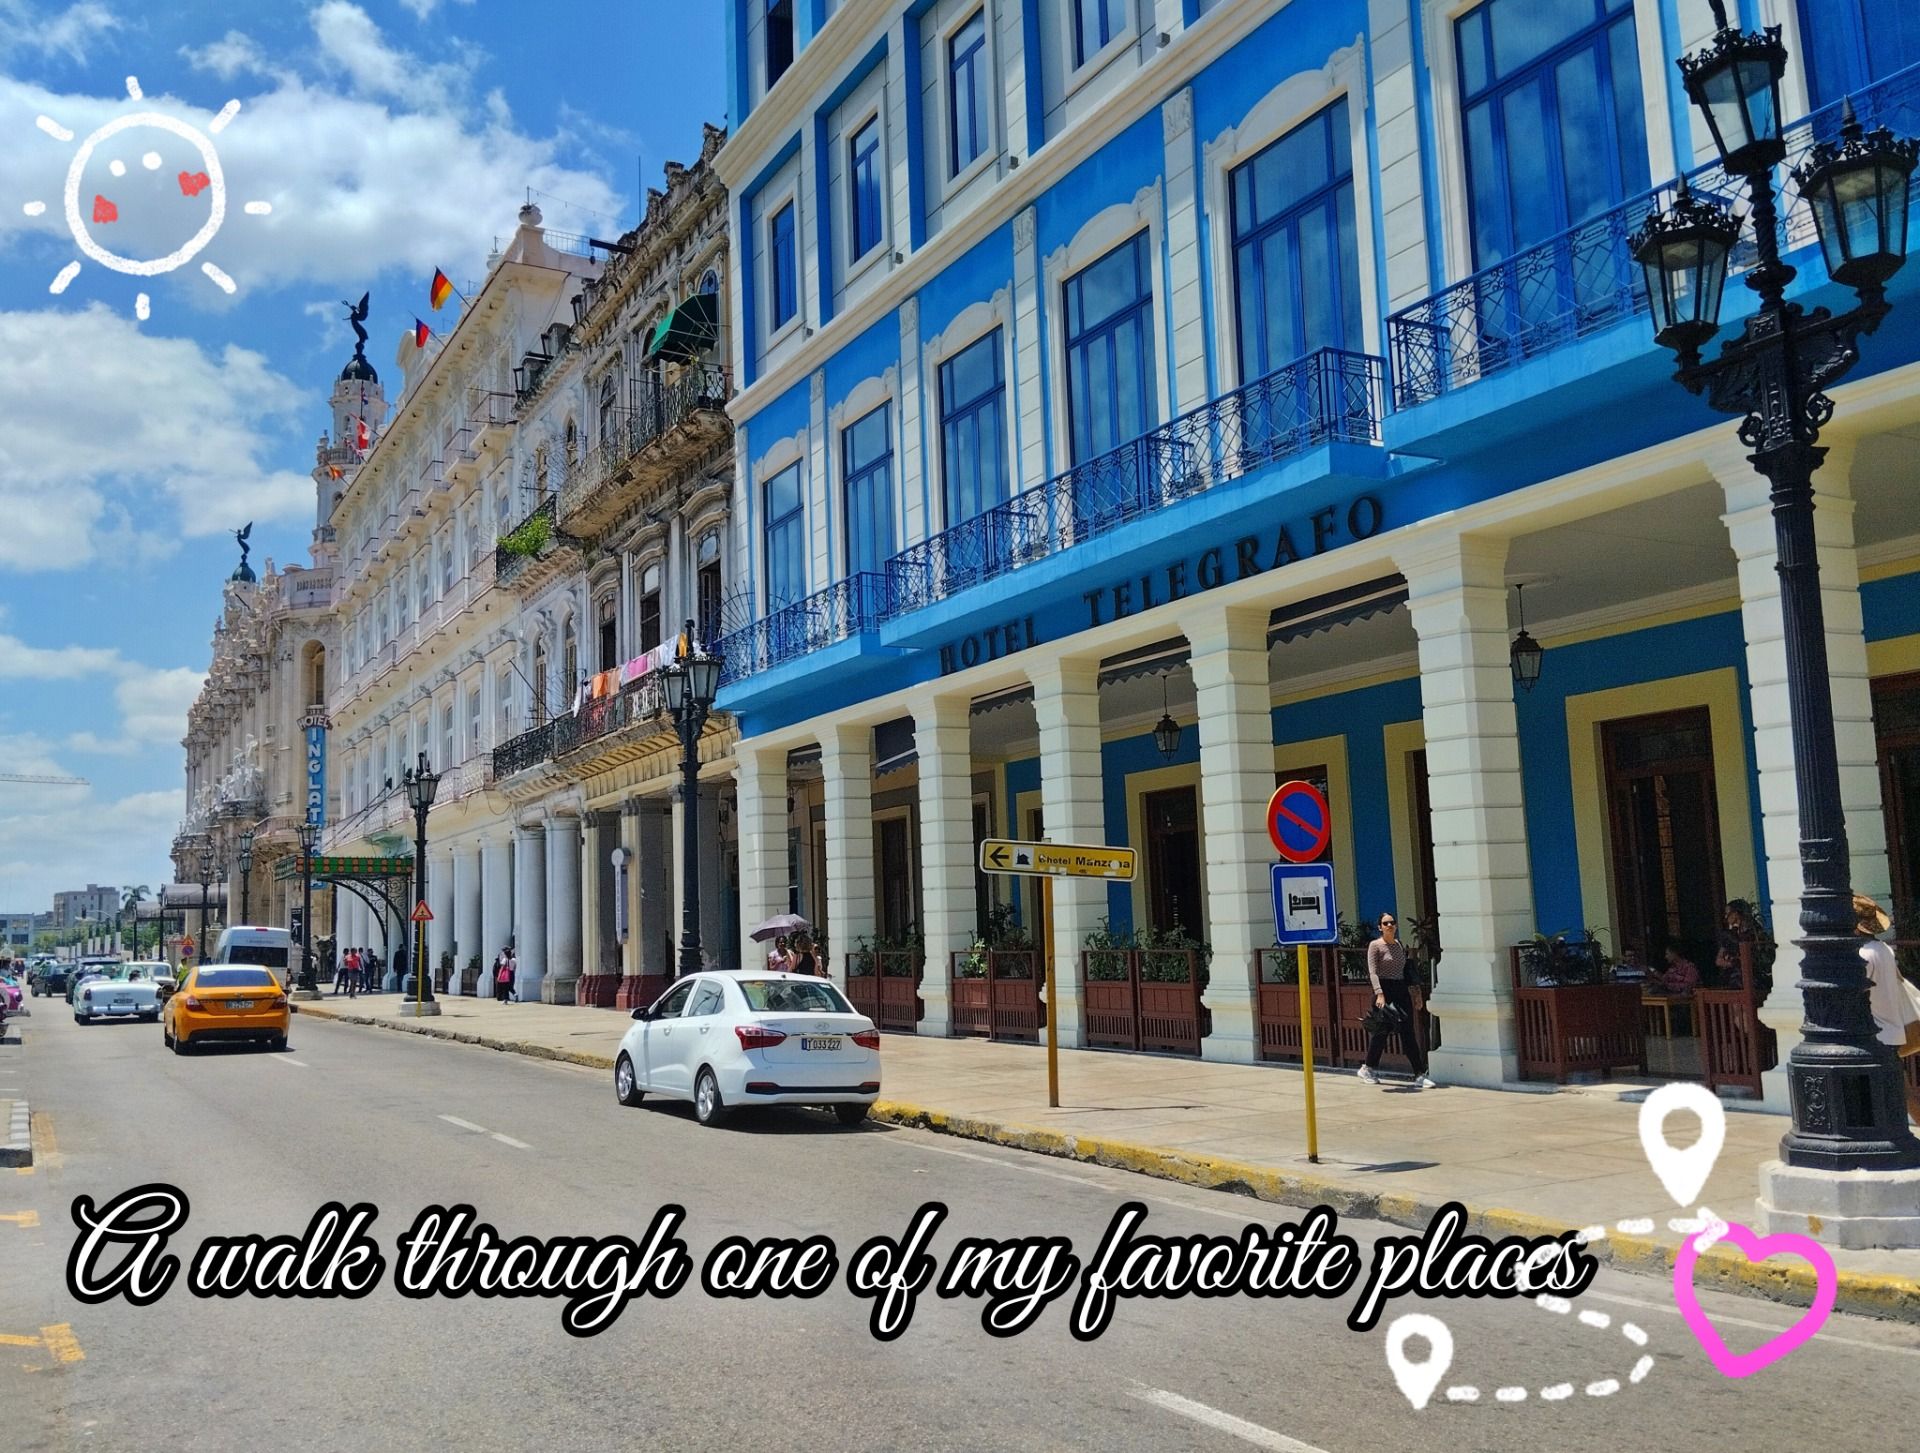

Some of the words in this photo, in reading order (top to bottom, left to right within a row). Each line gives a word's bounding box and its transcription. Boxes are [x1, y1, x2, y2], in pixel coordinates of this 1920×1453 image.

[938, 615, 1039, 677] HOTEL
[1083, 496, 1383, 628] TELEGRAFO
[297, 714, 330, 730] HOTEL
[308, 727, 322, 888] INGLAT
